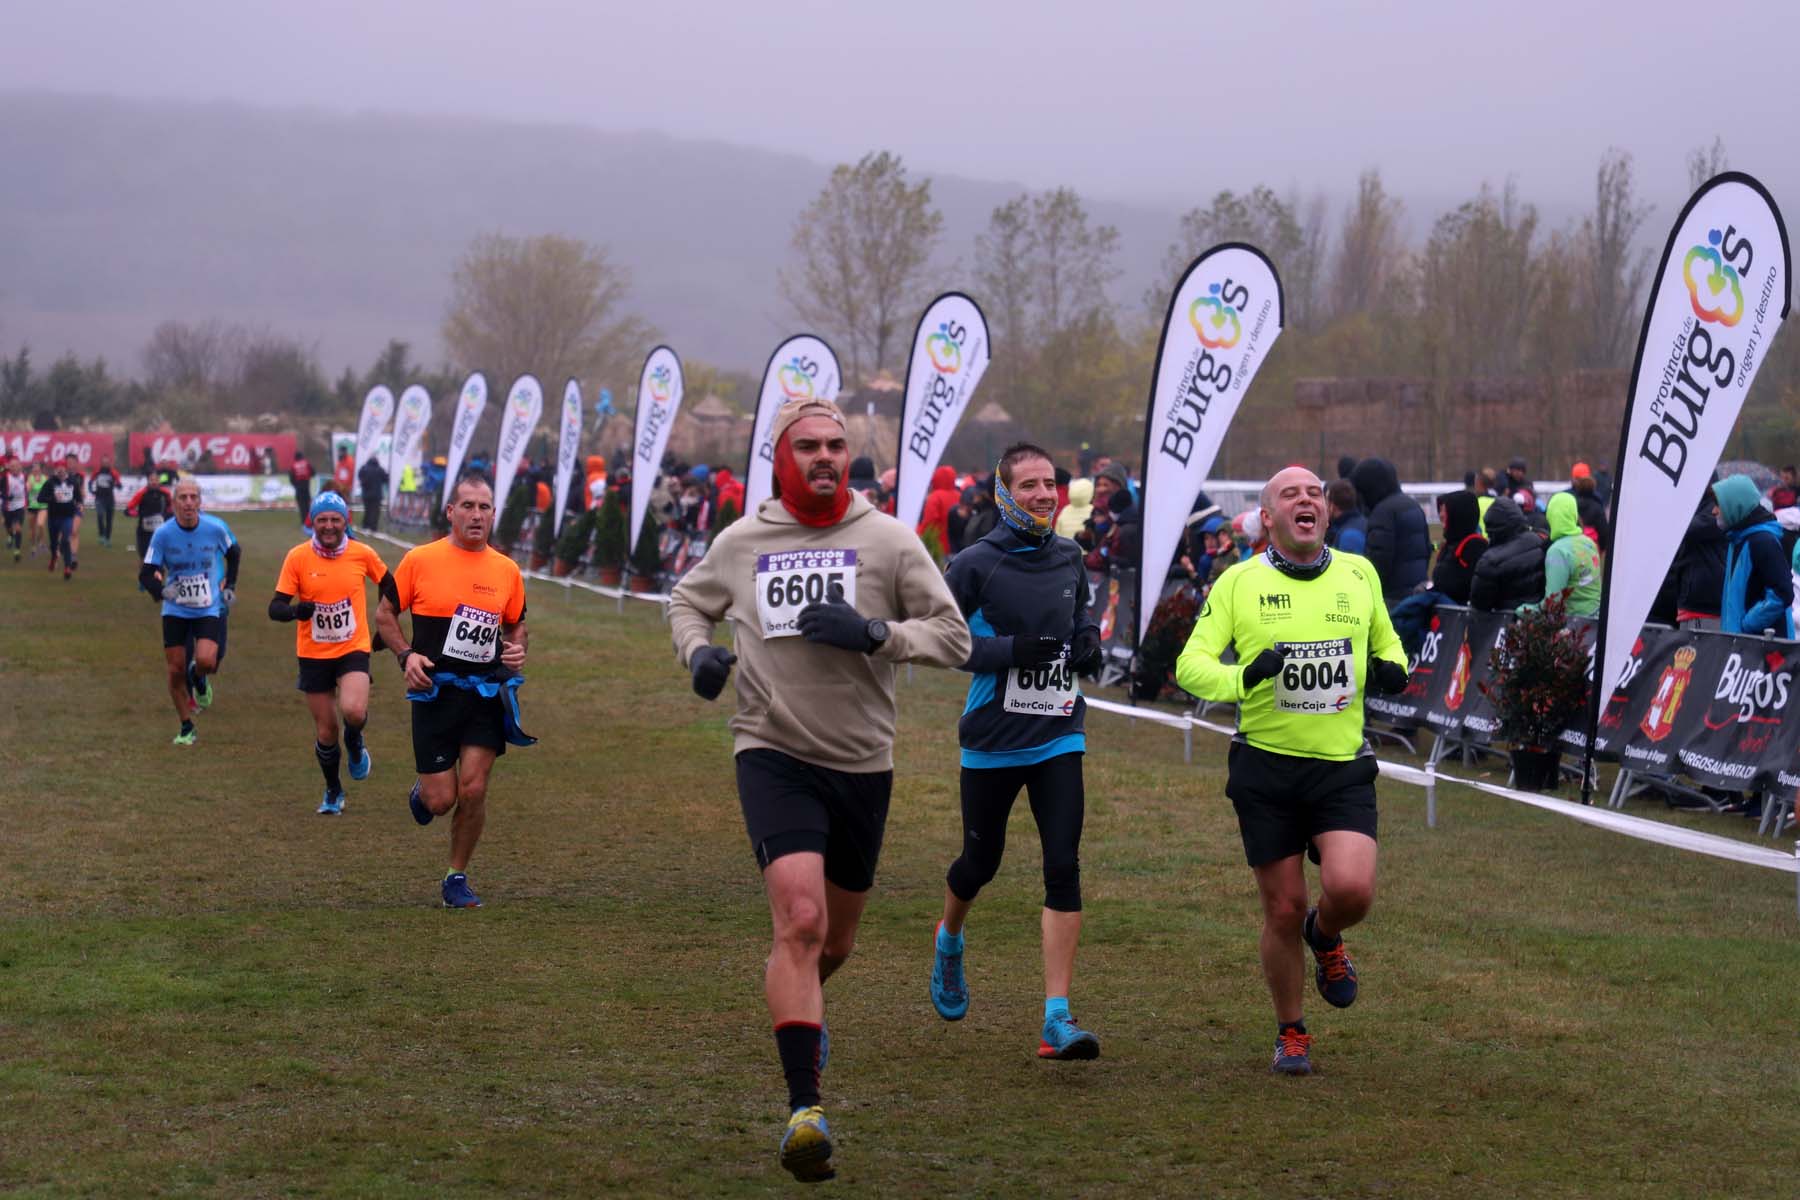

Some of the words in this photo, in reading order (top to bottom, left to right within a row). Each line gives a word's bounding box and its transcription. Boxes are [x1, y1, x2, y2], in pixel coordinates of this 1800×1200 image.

[1737, 339, 1757, 389] origen
[1755, 266, 1778, 320] destino
[1639, 224, 1754, 488] Burgos
[1160, 278, 1249, 470] Burgos
[1649, 333, 1687, 418] Provincia
[1166, 360, 1196, 424] Provincia
[768, 551, 845, 563] DIPUTACIÓN
[768, 559, 845, 572] BURGOS
[179, 583, 207, 597] 6171
[316, 610, 350, 630] 6187
[1325, 613, 1361, 626] SEGOVIA
[455, 621, 497, 647] 6494
[447, 646, 480, 659] iberCaja
[1017, 663, 1072, 692] 6049
[1283, 660, 1348, 691] 6004
[1714, 653, 1792, 723] Burgos
[1010, 699, 1054, 712] iberCaja
[1280, 700, 1326, 712] iberCaja
